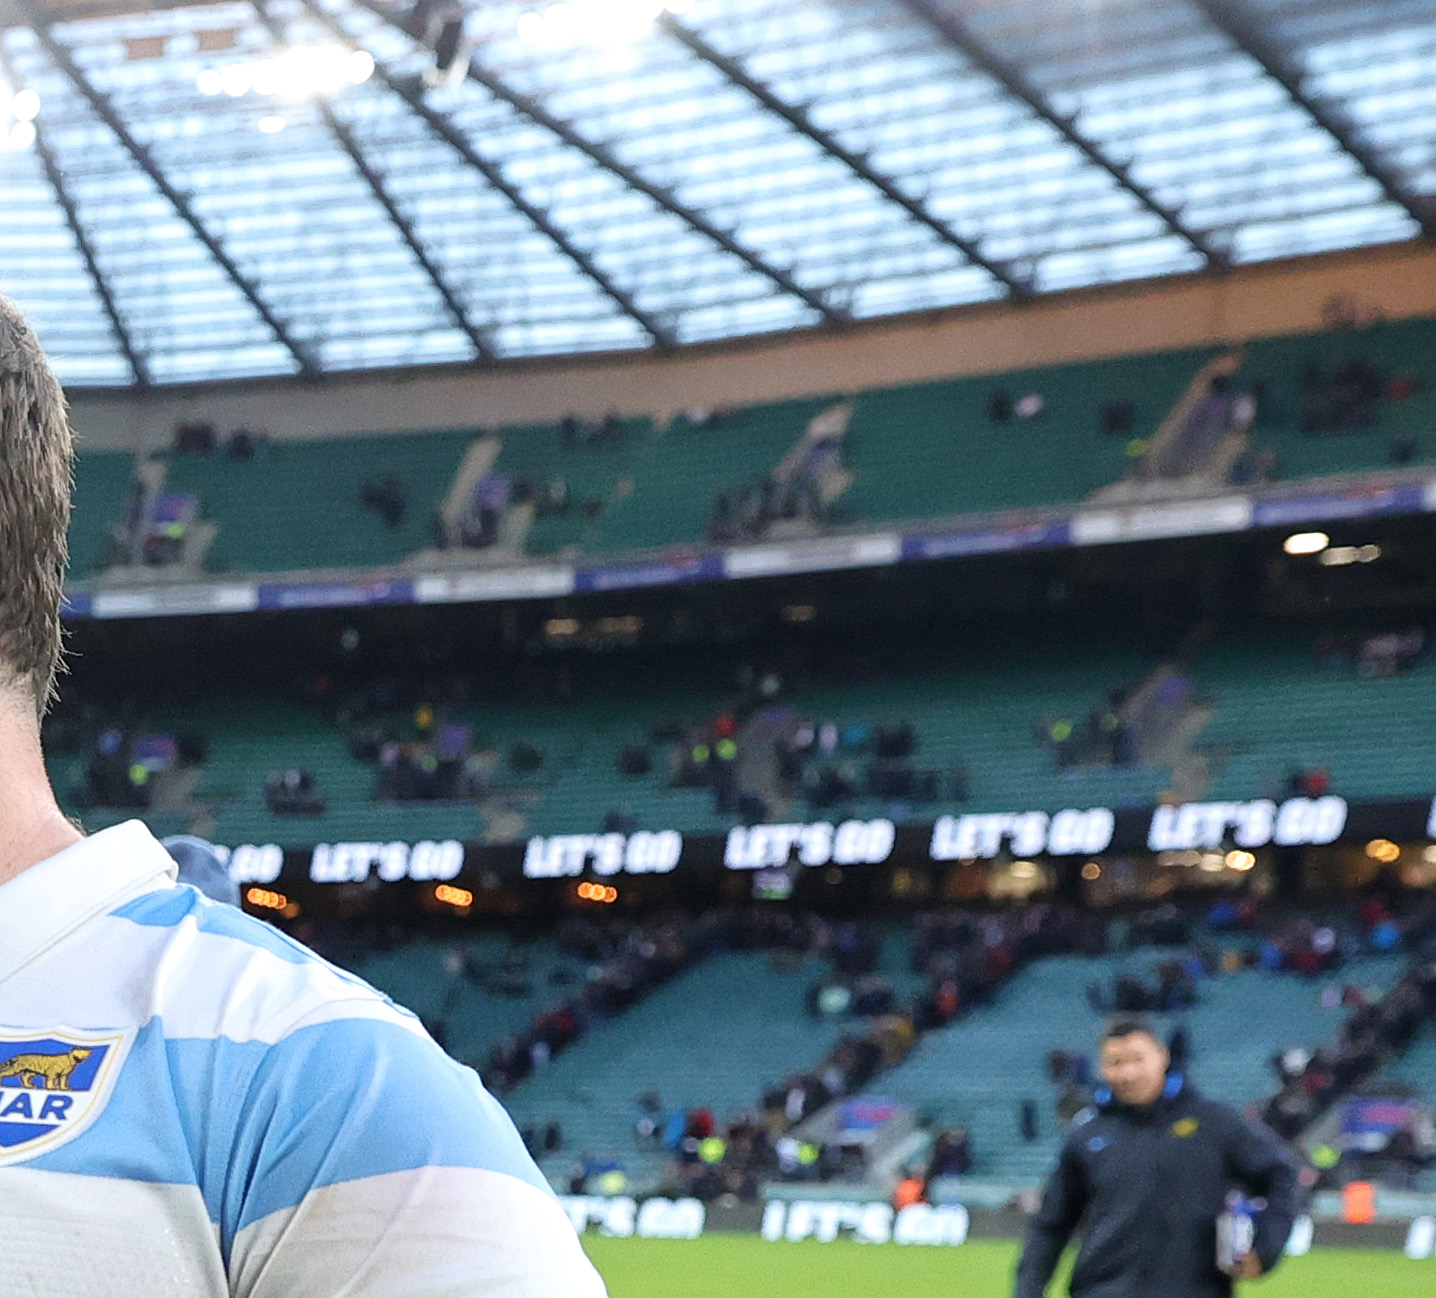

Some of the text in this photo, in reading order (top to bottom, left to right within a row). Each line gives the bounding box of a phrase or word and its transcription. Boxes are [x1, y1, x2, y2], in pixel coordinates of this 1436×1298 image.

[725, 818, 896, 870] LET'S GO
[931, 808, 1115, 860] LET'S GO
[1148, 796, 1347, 850] LET'S GO
[310, 839, 464, 882] LET'S GO
[523, 829, 683, 878] LET'S GO
